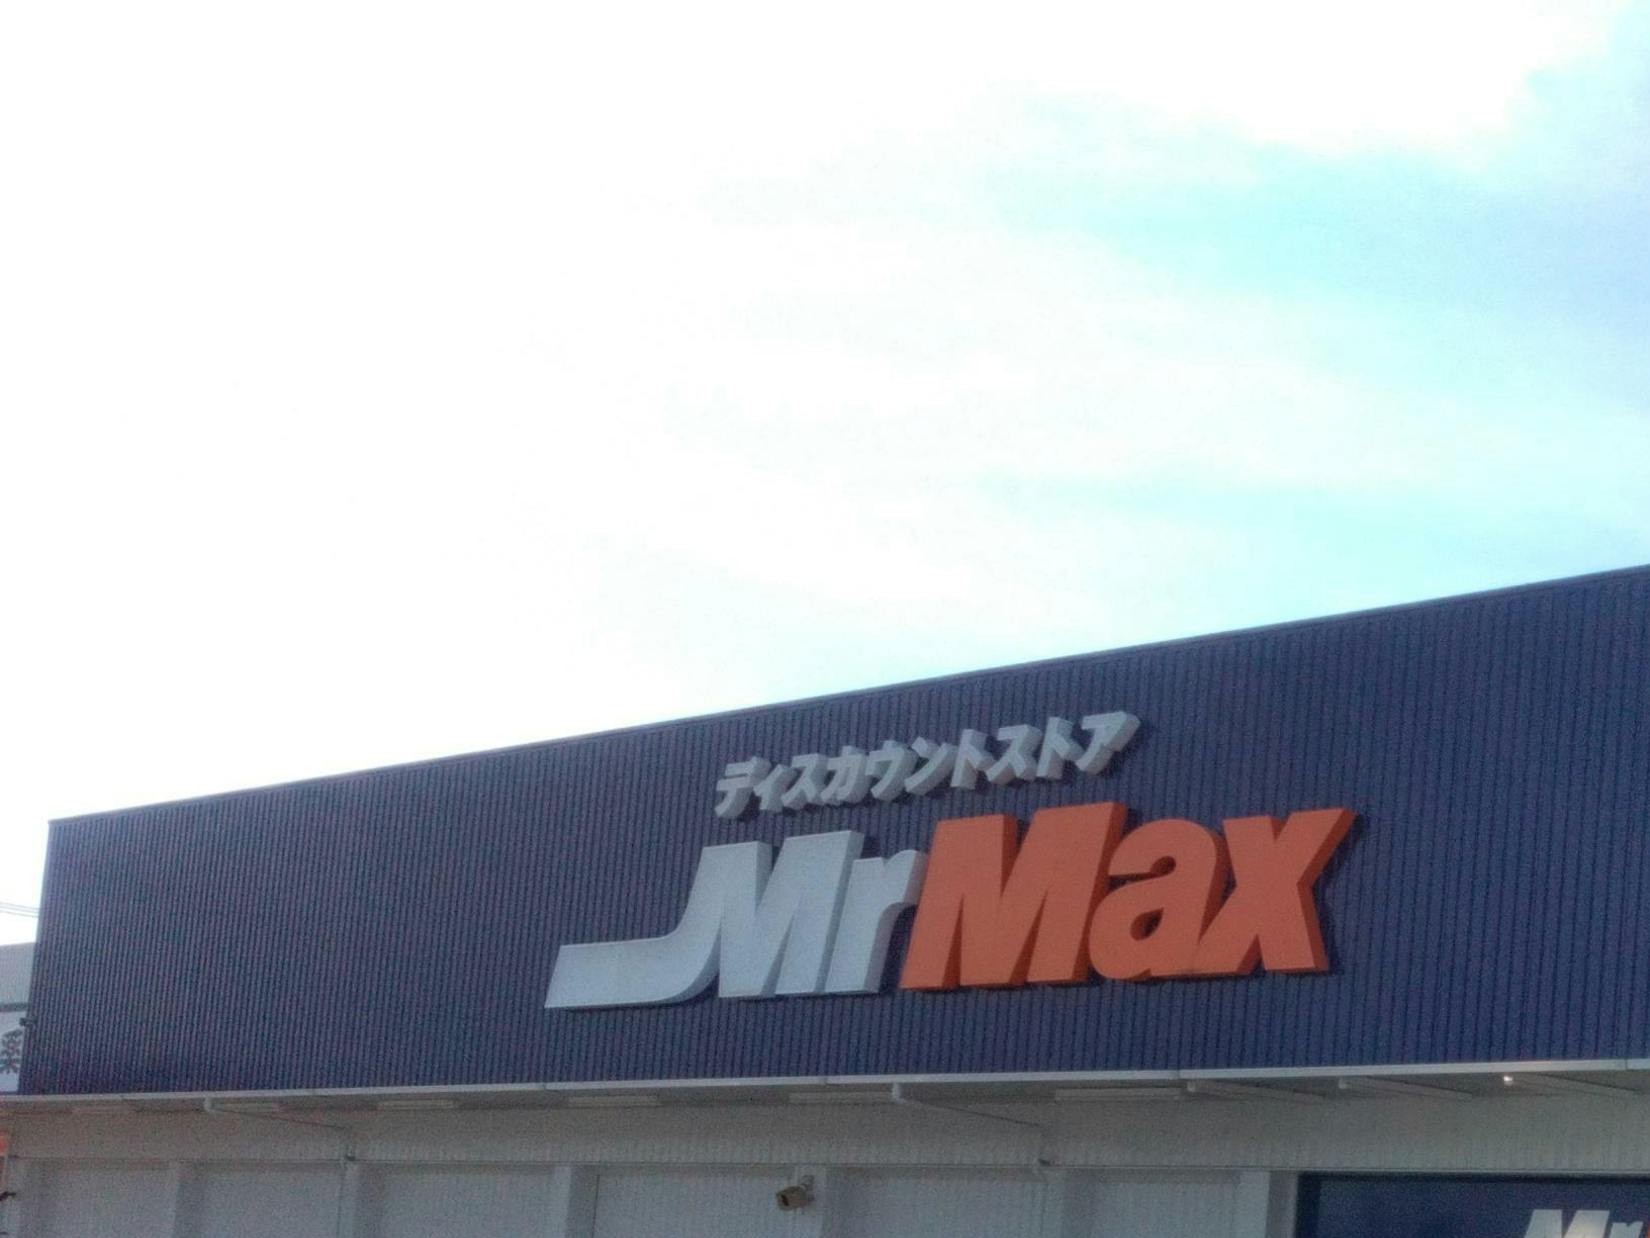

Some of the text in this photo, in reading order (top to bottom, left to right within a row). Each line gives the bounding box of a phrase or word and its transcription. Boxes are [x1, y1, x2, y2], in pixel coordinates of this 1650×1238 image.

[714, 710, 1142, 820] ディスカウントストア
